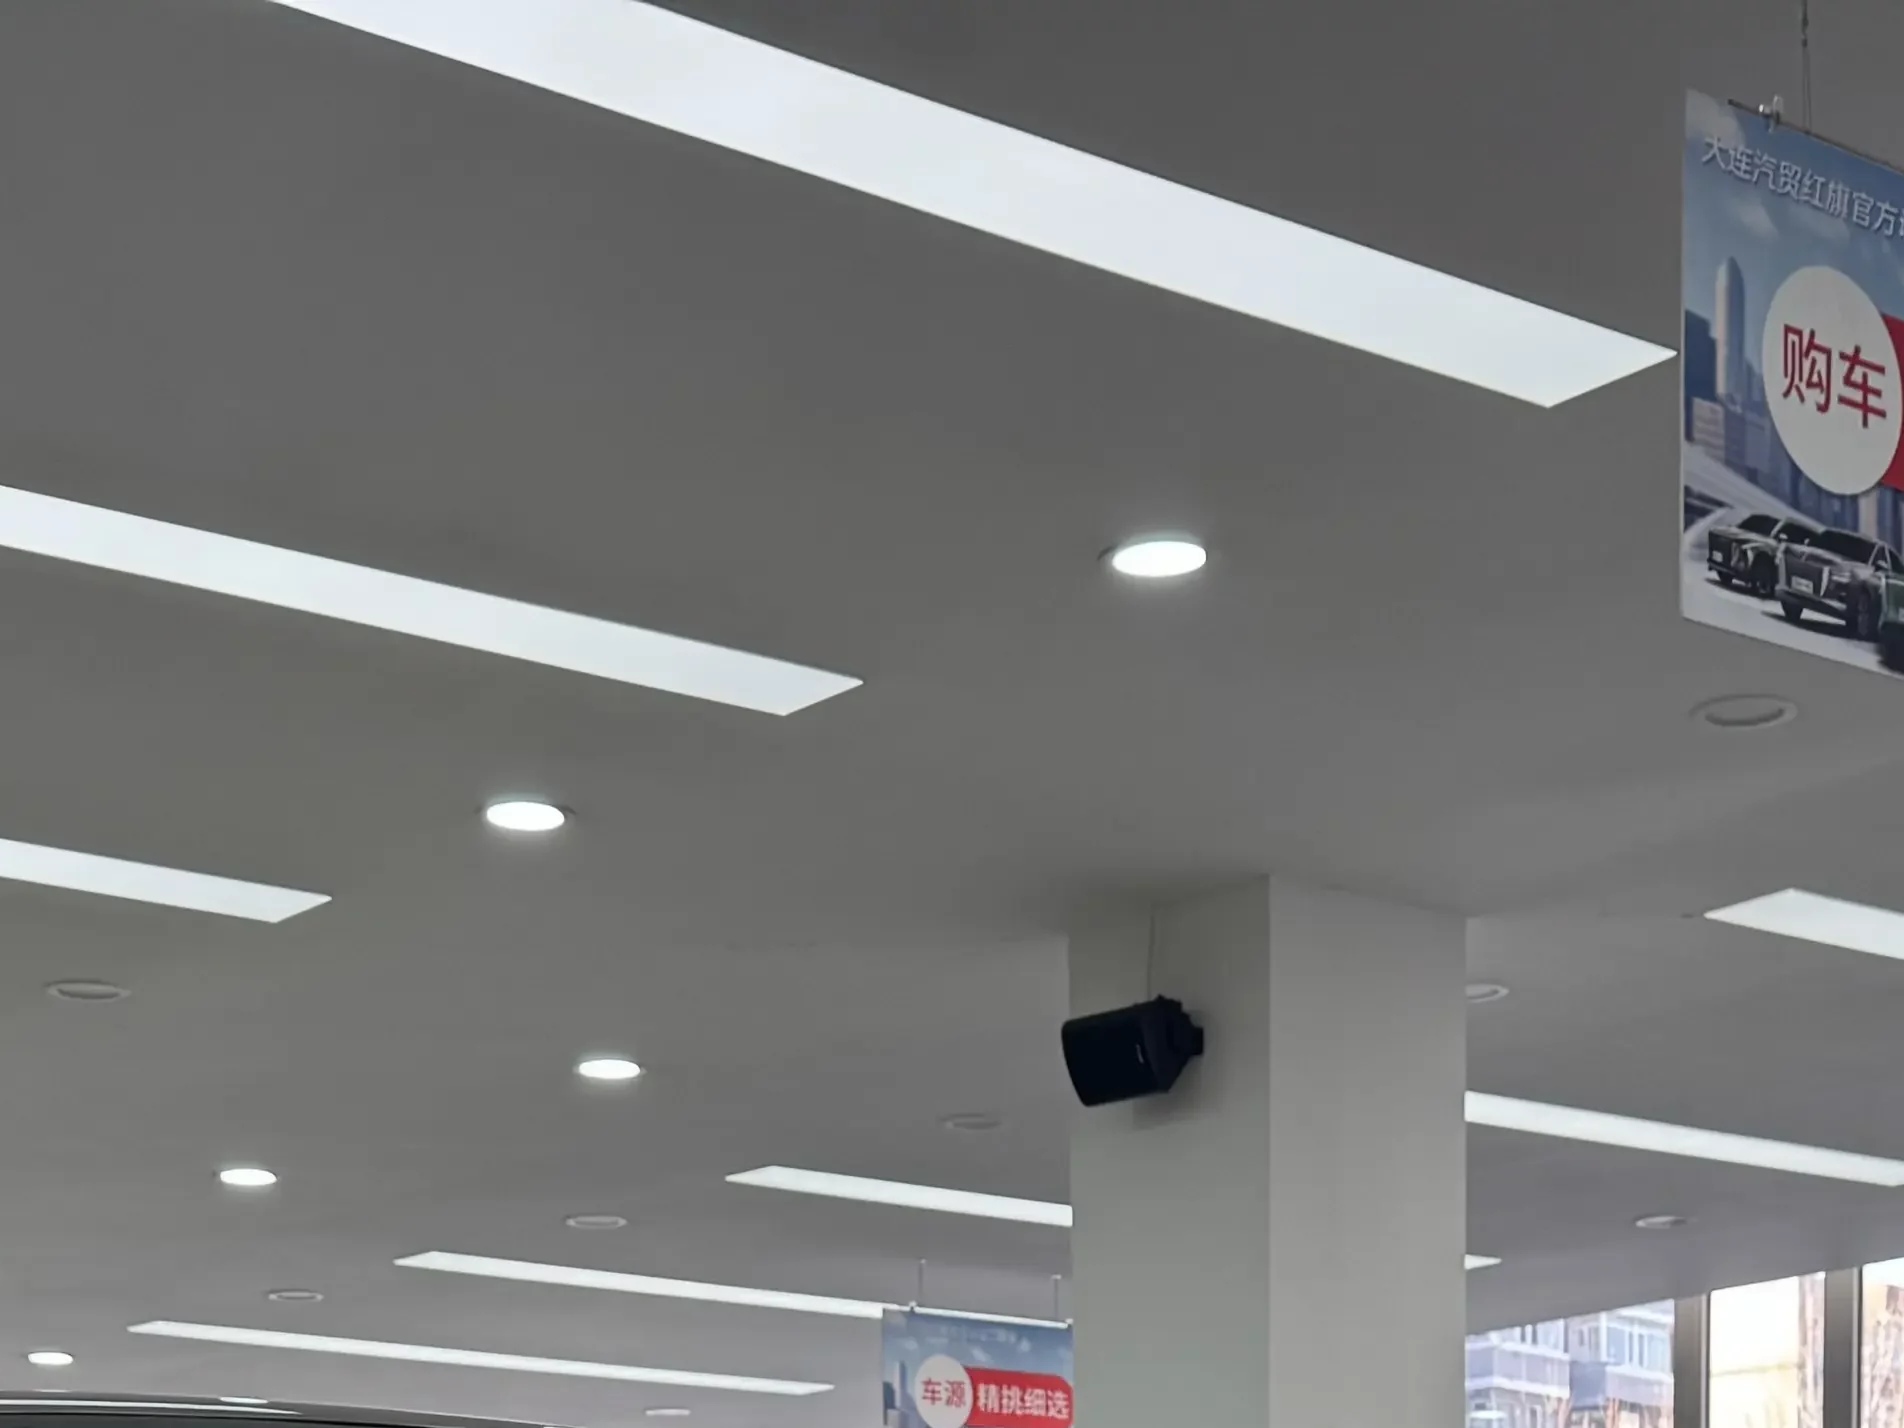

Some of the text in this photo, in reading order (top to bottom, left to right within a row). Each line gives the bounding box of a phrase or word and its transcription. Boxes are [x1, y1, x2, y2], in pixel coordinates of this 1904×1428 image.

[1780, 323, 1888, 429] 购车
[921, 1377, 1070, 1421] 车源 精挑细选
